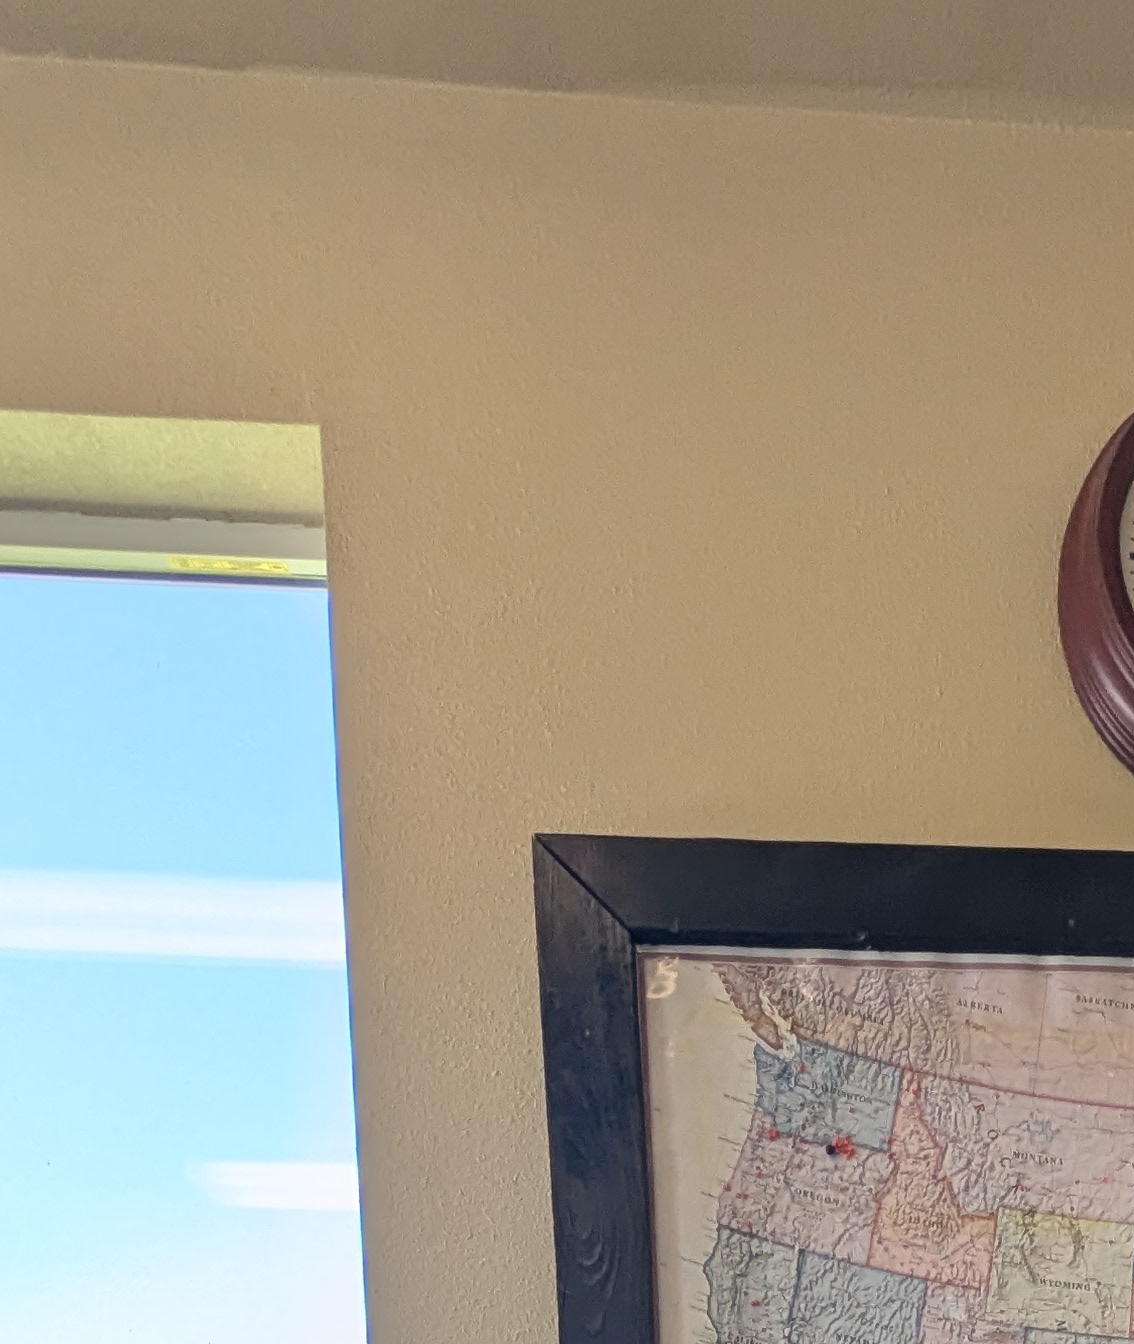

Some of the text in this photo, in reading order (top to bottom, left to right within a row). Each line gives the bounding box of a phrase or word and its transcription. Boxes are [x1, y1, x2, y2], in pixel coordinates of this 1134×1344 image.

[956, 999, 1003, 1015] ALBERTA
[1011, 1151, 1064, 1166] MONTANA
[1038, 1277, 1091, 1292] WYOMING
